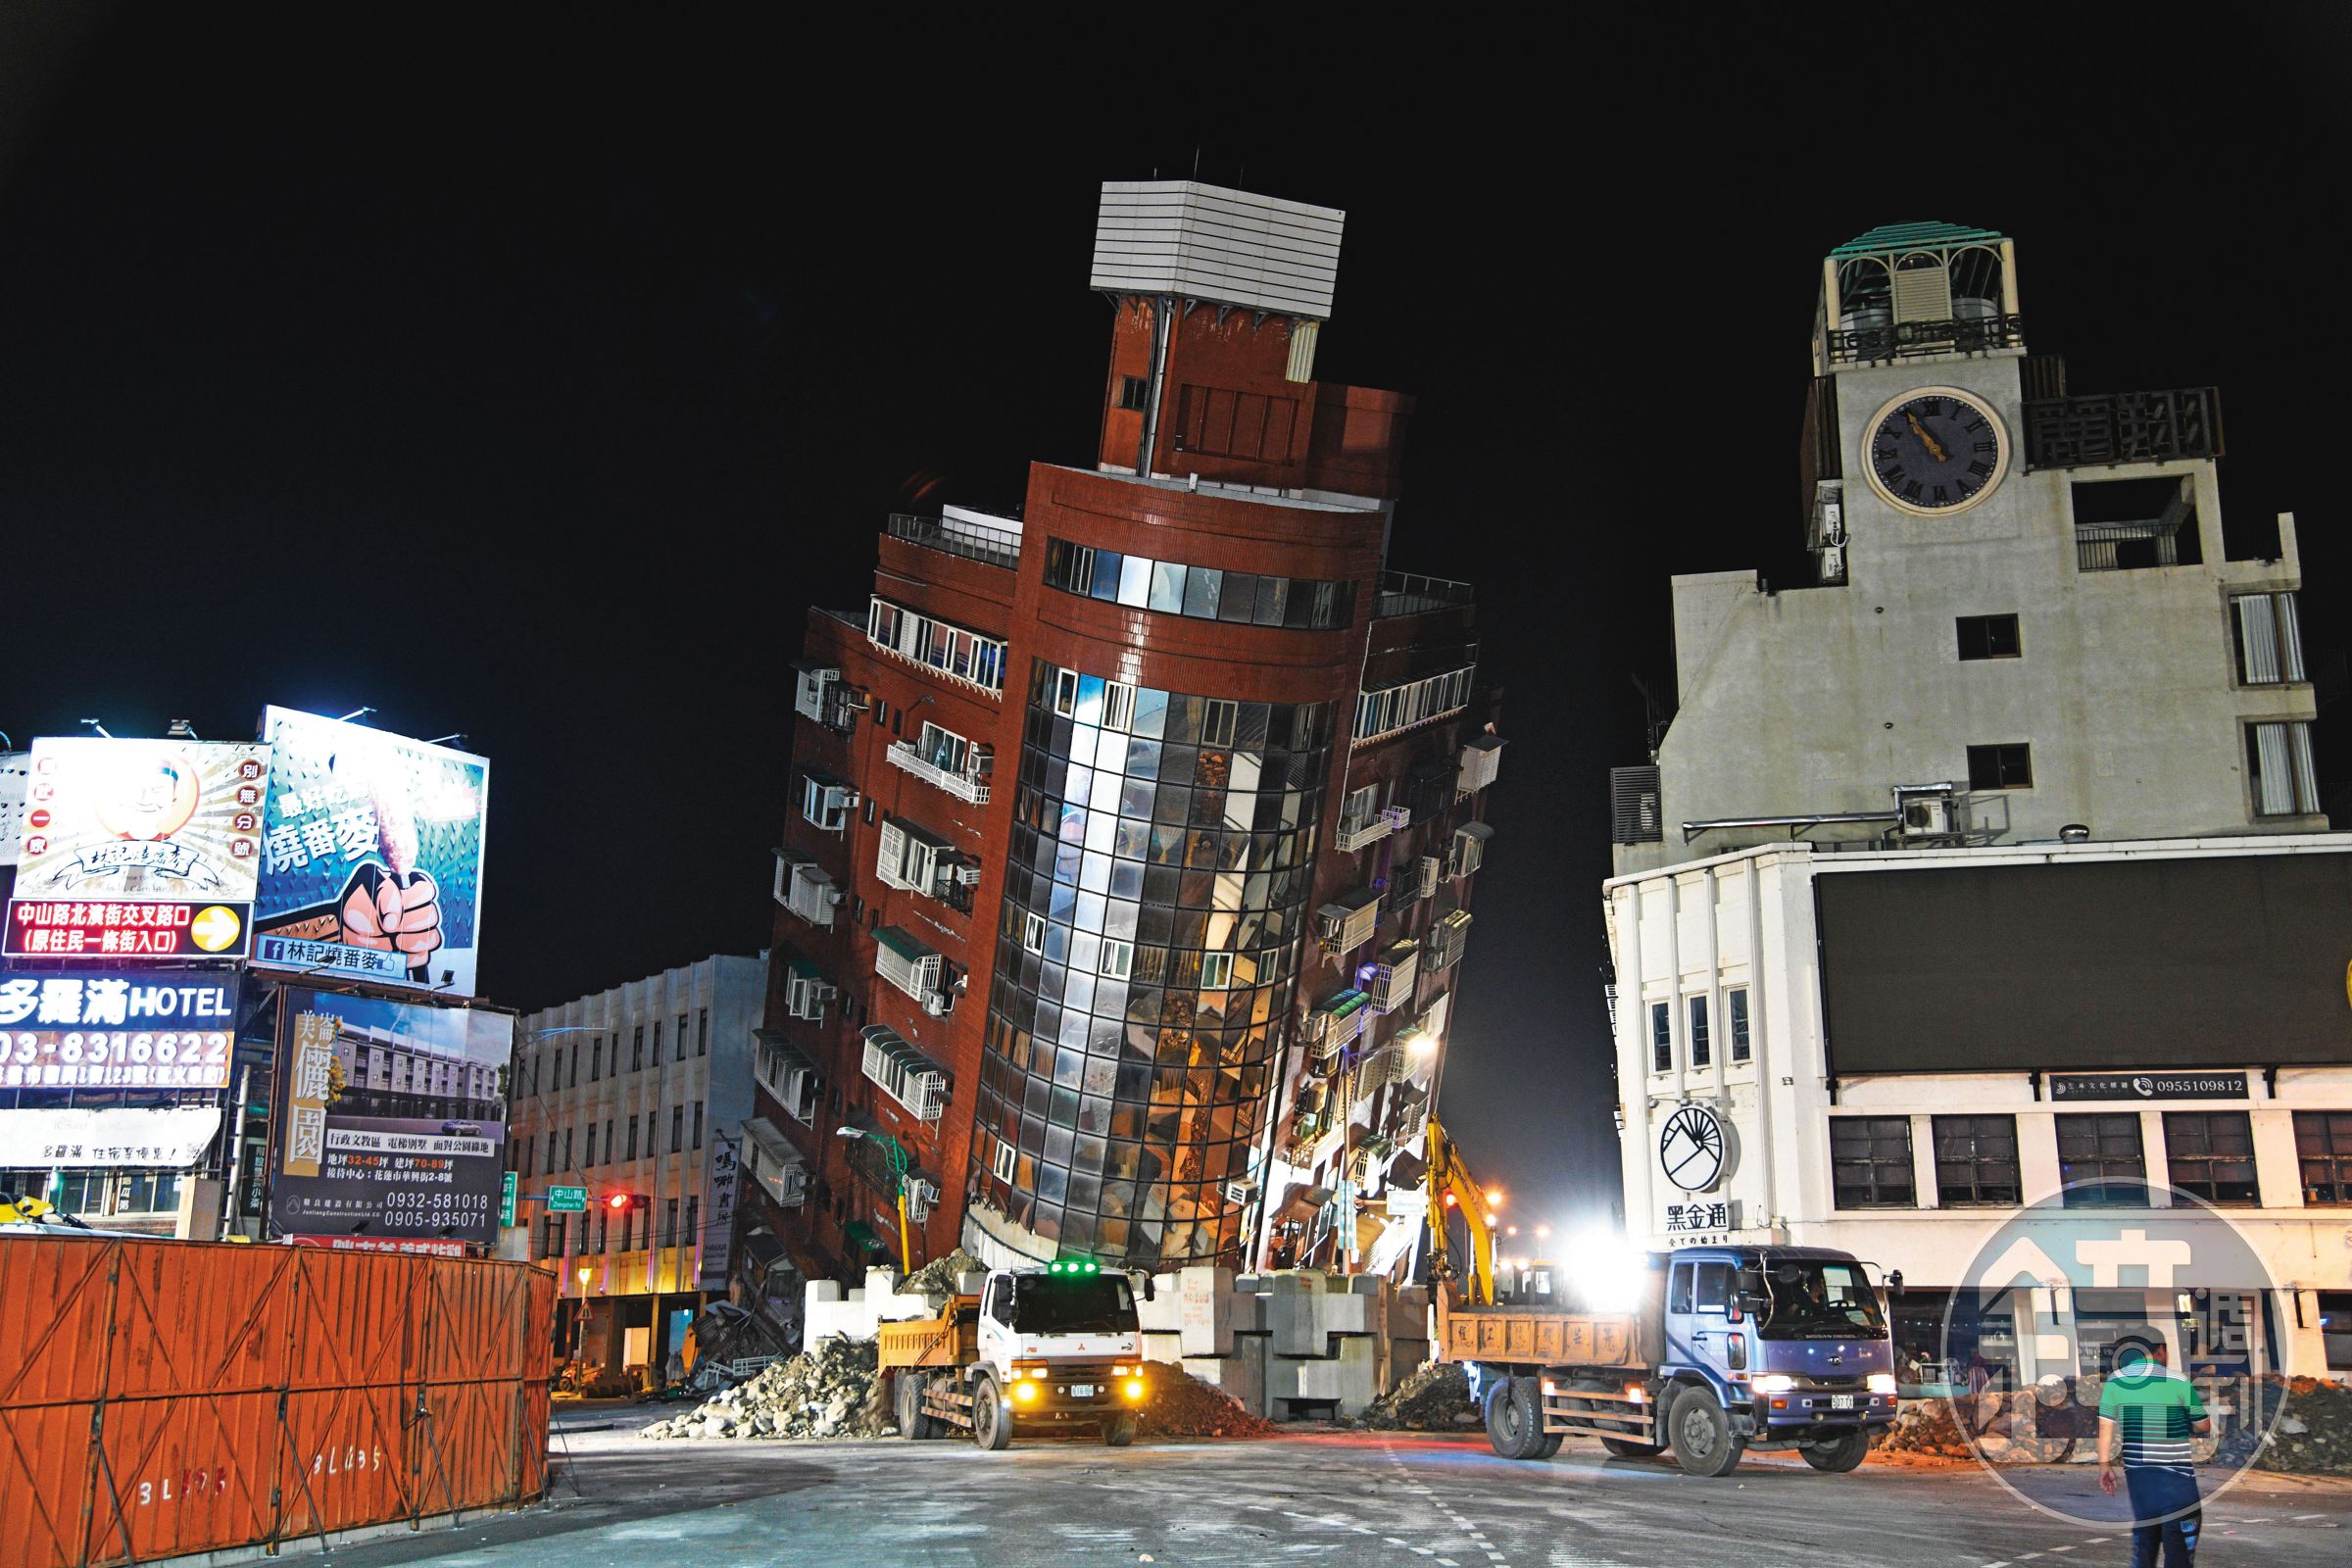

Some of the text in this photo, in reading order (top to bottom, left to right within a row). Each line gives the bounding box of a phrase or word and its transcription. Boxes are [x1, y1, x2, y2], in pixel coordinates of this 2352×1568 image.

[233, 764, 259, 855] 別無分號
[262, 806, 379, 875] 燒番麥
[18, 903, 191, 927] 中山路北濱街交叉路口
[24, 928, 178, 954] (原住民一條街入口)
[0, 978, 232, 1024] 多羅滿 HOTEL
[2157, 1079, 2242, 1093] 0955109812
[330, 1134, 381, 1149] 行政文教區
[387, 1137, 427, 1151] 電梯別墅
[327, 1153, 388, 1168] 地坪32-45坪
[387, 1192, 488, 1209] 0932-581018
[555, 1189, 583, 1200] 中山路
[384, 1210, 486, 1228] 0905-935071
[1667, 1202, 1727, 1231] 黑金通
[1669, 1235, 1728, 1247] 全ての始まり
